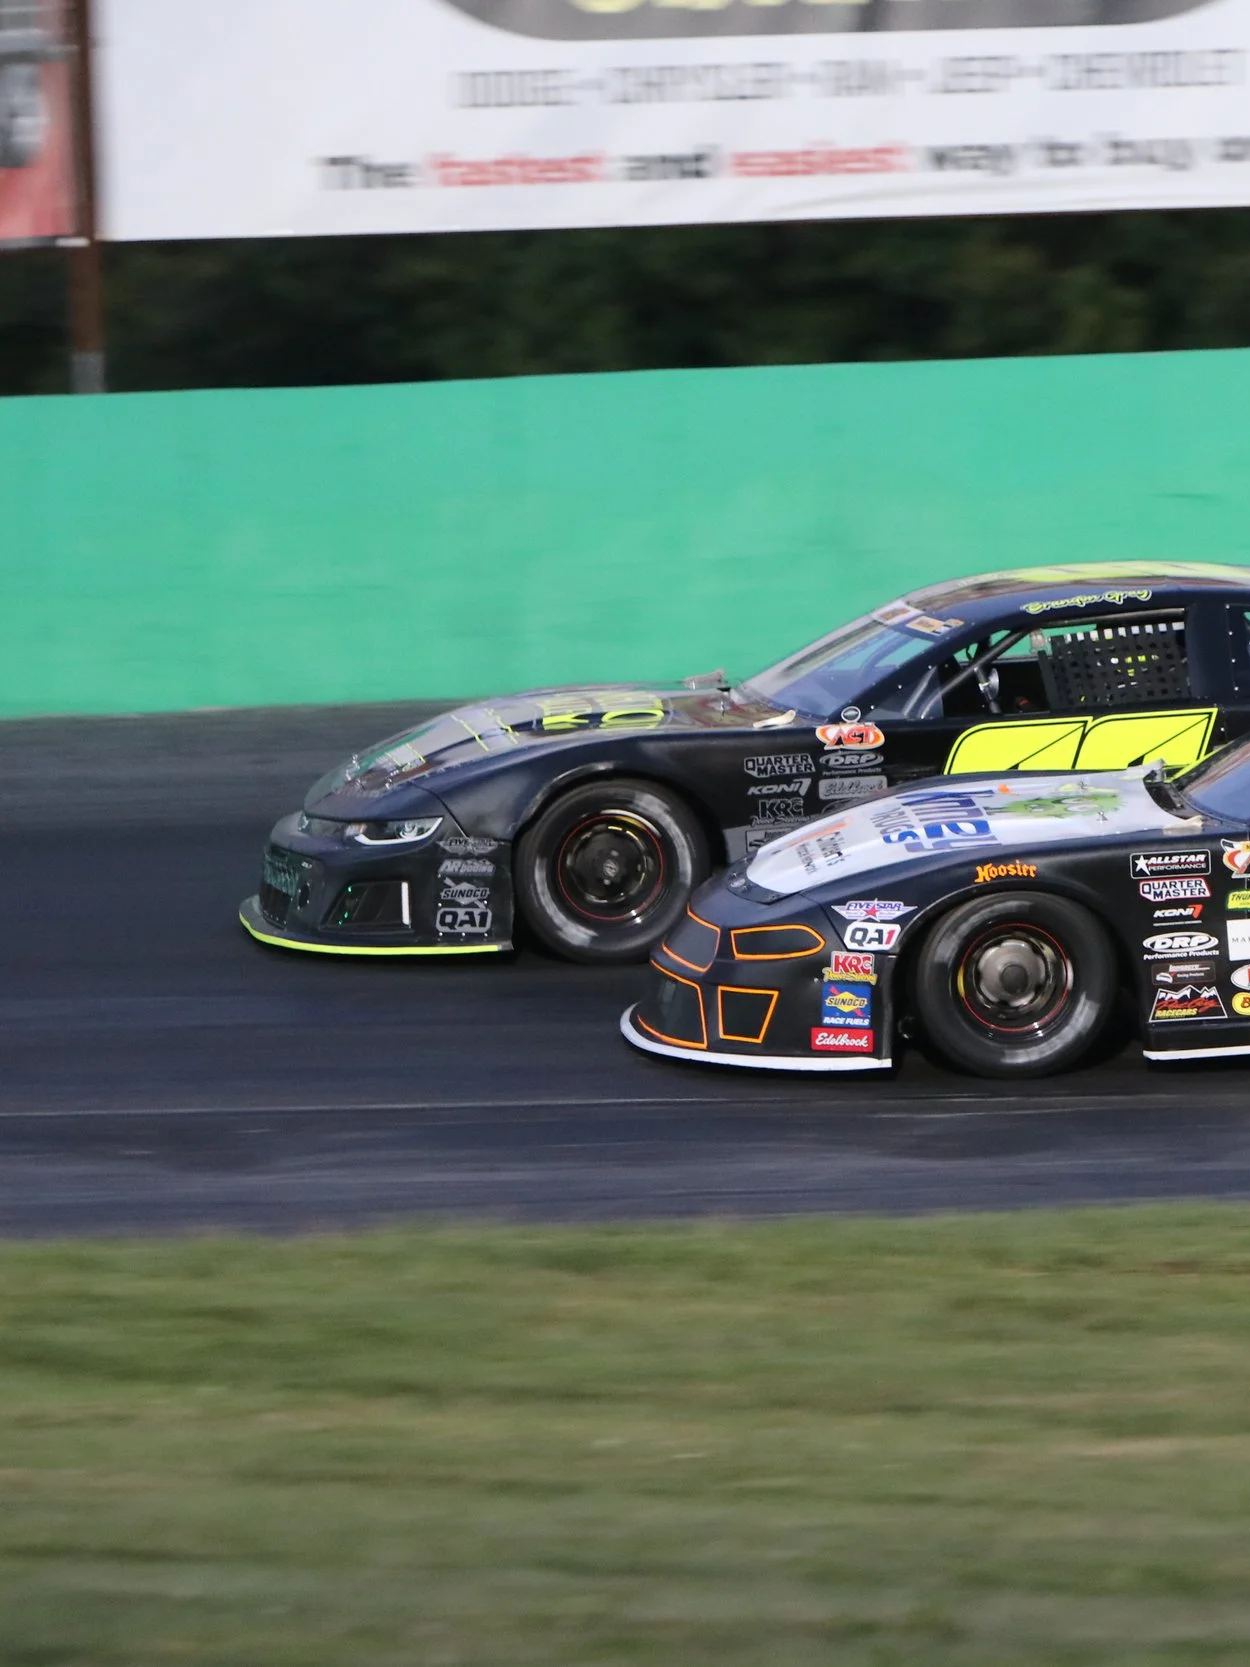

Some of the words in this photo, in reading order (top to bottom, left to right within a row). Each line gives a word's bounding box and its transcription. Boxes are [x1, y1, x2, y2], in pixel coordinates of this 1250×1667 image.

[746, 755, 808, 771] QUARTER
[829, 754, 877, 766] DRP
[757, 764, 813, 776] MASTER
[1148, 854, 1207, 865] ALLSTAR
[974, 860, 1037, 883] Hoosier
[1148, 863, 1207, 871] PERFORMANCE
[1142, 880, 1203, 895] QUARTER
[443, 889, 488, 899] SUNOCO
[1153, 888, 1207, 900] MASTER
[439, 911, 489, 930] QA1
[850, 927, 896, 946] QA1
[1153, 936, 1209, 950] DRP
[1144, 952, 1188, 960] Performance
[833, 954, 873, 974] KRC
[827, 997, 866, 1007] SUNOCO
[823, 1017, 846, 1025] RACE
[845, 1017, 870, 1025] FUELS
[815, 1032, 869, 1048] Edelbrock
